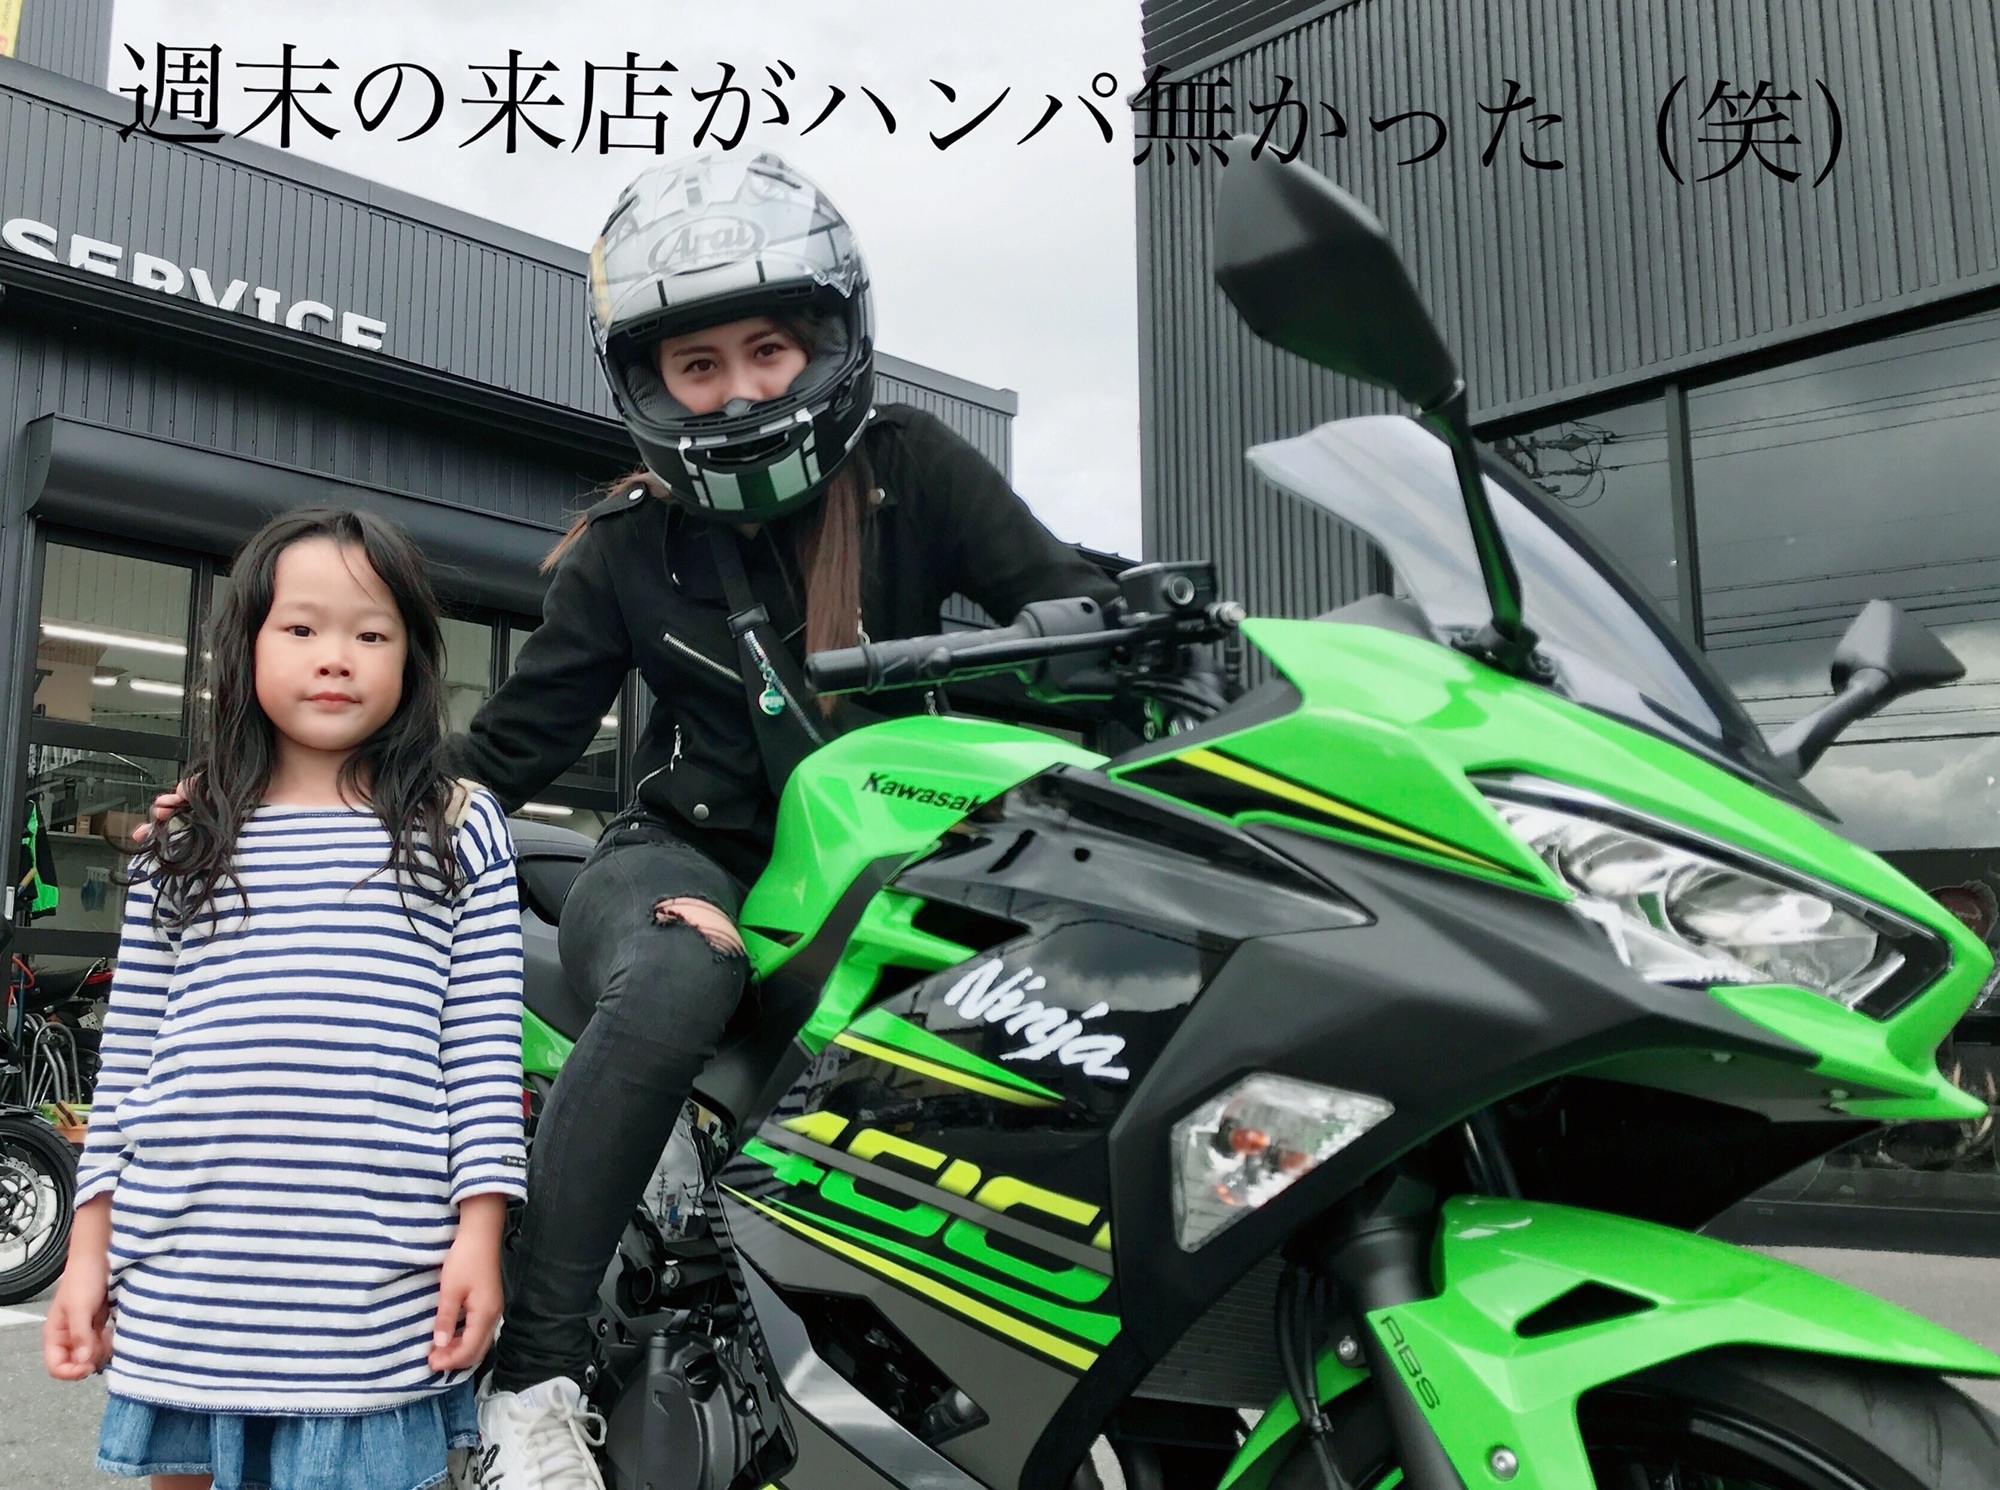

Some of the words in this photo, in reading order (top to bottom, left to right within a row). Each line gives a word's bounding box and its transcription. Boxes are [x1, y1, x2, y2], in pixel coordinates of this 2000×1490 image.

[660, 219, 752, 268] Arai
[862, 772, 990, 813] Kawasak
[944, 958, 1130, 1080] Ninja
[1380, 1316, 1441, 1409] ABS
